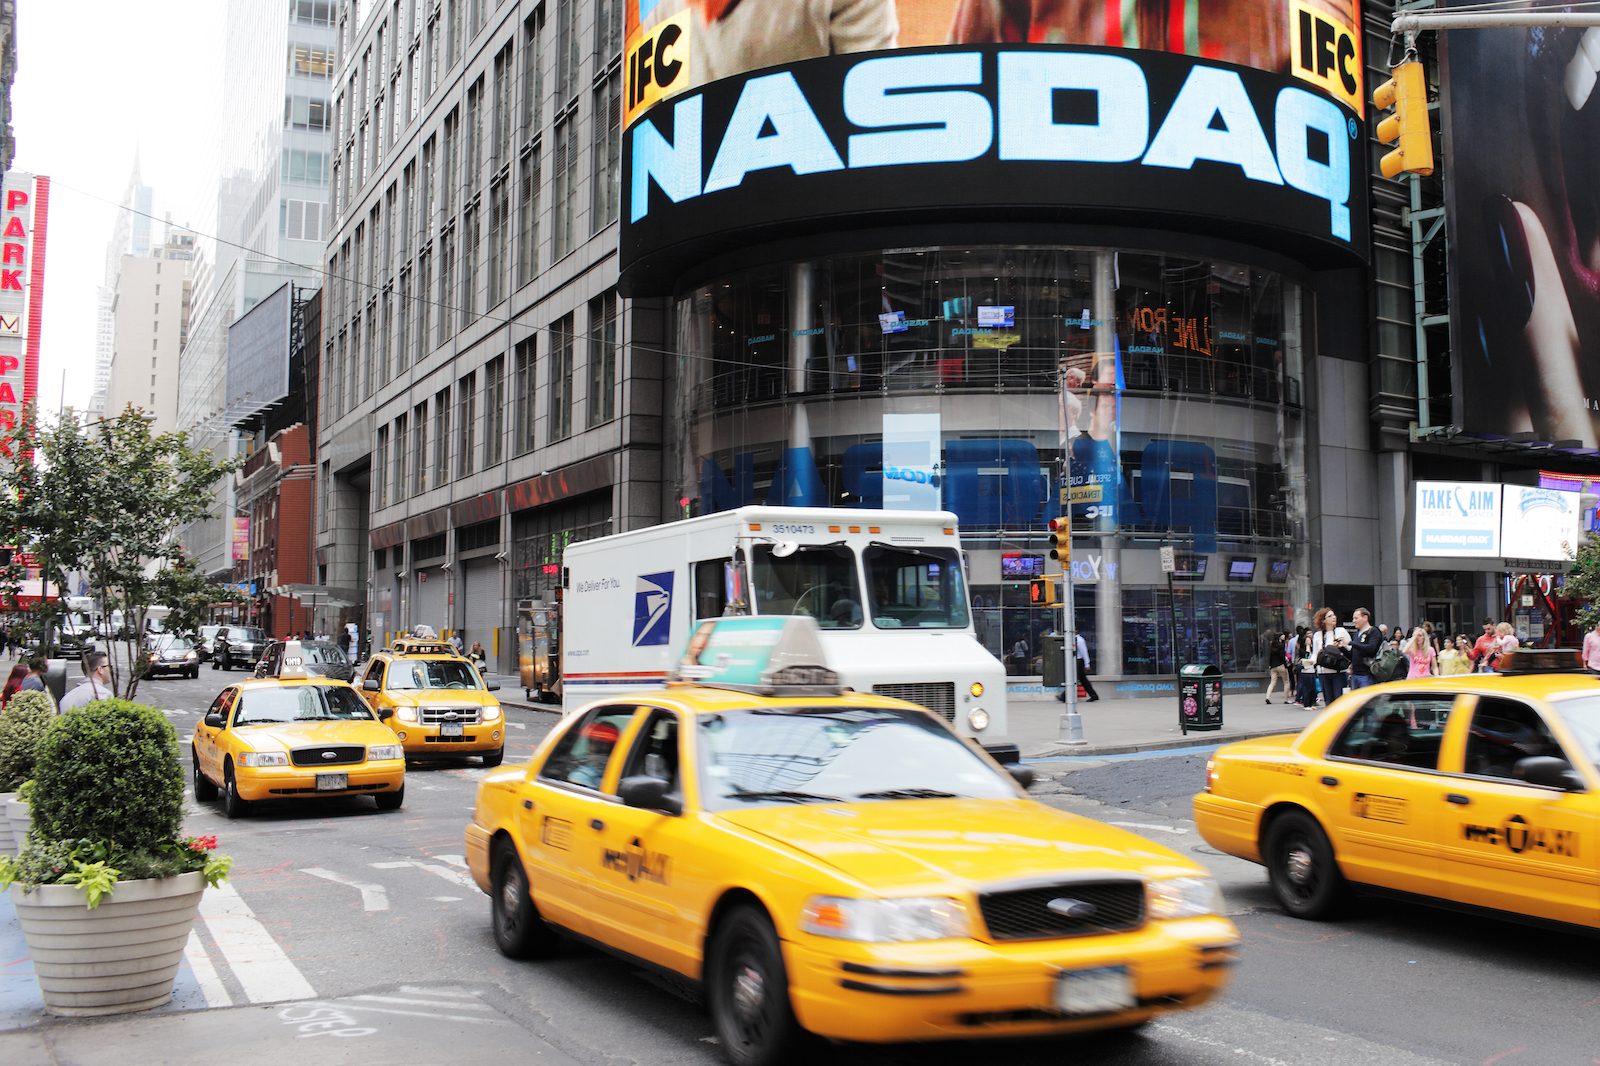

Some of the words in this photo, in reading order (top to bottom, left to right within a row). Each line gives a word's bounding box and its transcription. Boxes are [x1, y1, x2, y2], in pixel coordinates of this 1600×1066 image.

[1299, 9, 1356, 95] IFC
[629, 24, 682, 112] IFC
[631, 51, 1352, 242] NASDAQ
[1, 190, 28, 291] PARK
[1422, 490, 1452, 509] TAKE
[1469, 491, 1494, 510] AIM
[1422, 510, 1452, 518] PROSTATE
[772, 524, 815, 534] 3510473
[1426, 535, 1467, 546] NASDAQ
[1467, 536, 1490, 544] OMX
[577, 582, 584, 593] We
[585, 580, 601, 592] Deliver
[601, 578, 610, 590] For
[610, 577, 621, 588] You.
[1116, 684, 1155, 693] NASDAQ
[1222, 681, 1246, 690] ASDAQ
